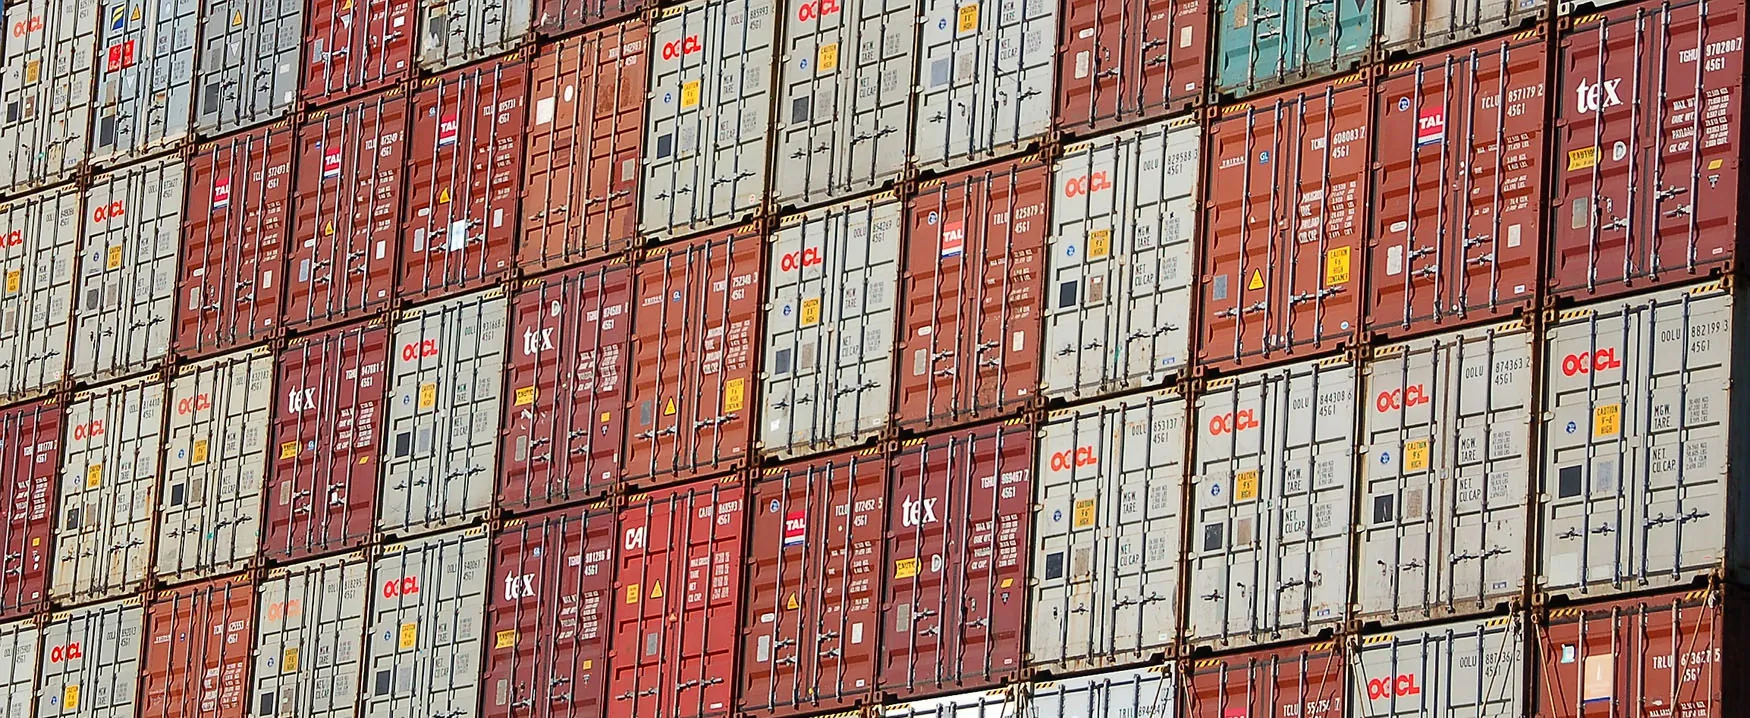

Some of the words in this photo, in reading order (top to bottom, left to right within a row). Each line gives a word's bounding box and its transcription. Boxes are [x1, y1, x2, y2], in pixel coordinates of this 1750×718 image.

[663, 34, 702, 60] OOCL
[1481, 94, 1500, 109] TCLU
[1508, 86, 1536, 103] 857179
[1576, 77, 1623, 114] tex
[1507, 104, 1525, 117] 45G1
[440, 121, 457, 133] TAL
[1419, 115, 1443, 130] TAL
[1333, 130, 1359, 145] 608083
[324, 154, 341, 165] TAL
[1167, 151, 1192, 166] 829588
[1167, 164, 1183, 176] 45G1
[1065, 170, 1111, 198] OOCL
[943, 231, 964, 243] TAL
[781, 247, 822, 272] OOCL
[1661, 328, 1681, 343] OOLU
[1691, 322, 1721, 338] 882199
[1723, 319, 1729, 331] 3
[523, 325, 555, 355] tex
[1691, 340, 1711, 353] 45G1
[402, 339, 438, 361] OOCL
[1465, 365, 1484, 379] OOLU
[1495, 357, 1523, 373] 874363
[1562, 347, 1620, 377] OOCL
[1494, 373, 1513, 385] 45G1
[1319, 391, 1345, 405] 844308
[1377, 384, 1429, 413] OOCL
[1319, 404, 1336, 417] 45G1
[1596, 404, 1618, 417] CAUTION
[1153, 418, 1177, 432] 853137
[1209, 409, 1258, 436] OOCL
[1153, 431, 1169, 444] 45G1
[1050, 445, 1097, 472] OOCL
[902, 494, 938, 528] tex
[786, 518, 806, 531] TAL
[383, 576, 420, 598] OOCL
[504, 570, 536, 601] tex
[1459, 655, 1476, 668] OOLU
[1485, 652, 1510, 665] 88736
[1485, 665, 1501, 678] 451
[1367, 673, 1420, 700] OOCL
